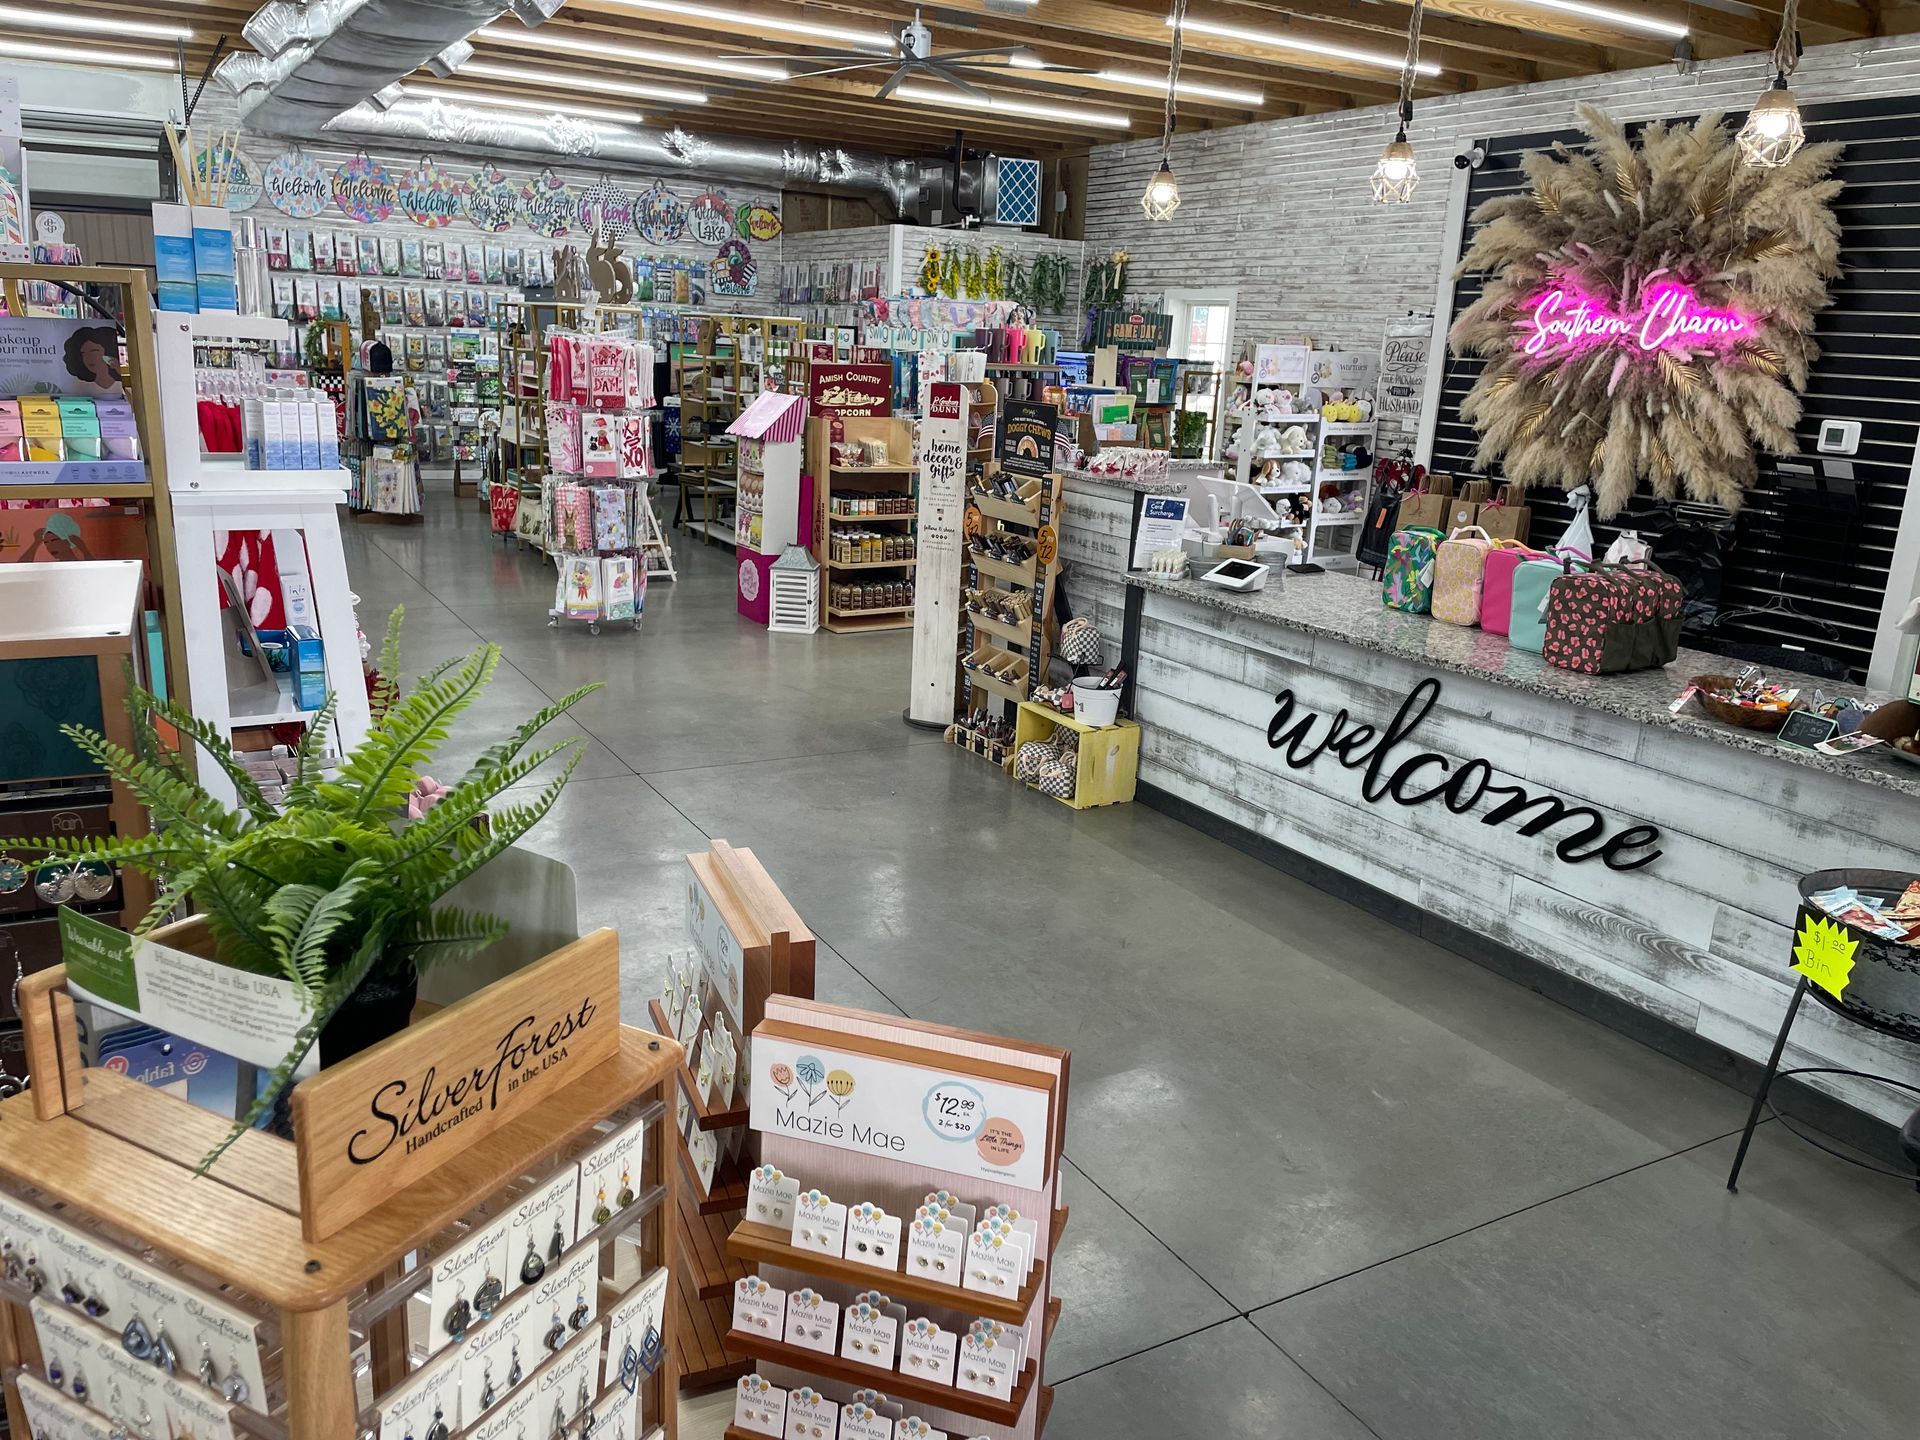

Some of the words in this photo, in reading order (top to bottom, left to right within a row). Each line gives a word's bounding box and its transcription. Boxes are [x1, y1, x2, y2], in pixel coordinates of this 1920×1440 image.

[270, 177, 327, 197] Welcome
[336, 179, 394, 201] Welcome
[404, 191, 458, 215] Welcome
[526, 198, 575, 217] Welcome
[1525, 291, 1633, 354] Southern
[1639, 290, 1744, 351] Charm
[829, 330, 850, 343] sig
[927, 328, 950, 347] swg
[22, 344, 57, 355] mind
[1385, 341, 1426, 363] Please
[834, 408, 871, 417] OPCORN
[932, 406, 958, 414] DUNN
[1379, 396, 1419, 413] HUSBAND
[1007, 423, 1027, 434] DOGGY
[1028, 425, 1052, 440] CHEWS
[931, 438, 962, 454] home
[954, 457, 963, 470] &
[930, 463, 956, 484] gifts
[492, 497, 515, 511] LOVE
[1149, 509, 1175, 518] Surcharge
[1038, 530, 1048, 545] 5
[1267, 678, 1664, 871] welcome
[66, 922, 106, 956] Wearable
[107, 949, 123, 962] art
[1803, 949, 1832, 978] Bin
[233, 975, 249, 991] the
[253, 981, 281, 999] USA
[406, 1098, 484, 1155] Handcrafted
[507, 1079, 519, 1092] in
[522, 1066, 539, 1084] the
[542, 1047, 568, 1070] USA
[775, 1107, 844, 1140] Mazie
[852, 1123, 906, 1153] Mae
[954, 1120, 971, 1132] $20
[1000, 1130, 1012, 1138] THE
[980, 1133, 1000, 1147] Little
[1000, 1135, 1022, 1150] Things
[998, 1146, 1010, 1155] LIFE
[752, 1184, 775, 1197] Mazie
[775, 1190, 793, 1200] Mae
[798, 1210, 821, 1223] Mazie
[822, 1216, 840, 1227] Mae
[851, 1224, 874, 1236] Mazie
[876, 1230, 894, 1240] Mae
[912, 1237, 935, 1250] Mazie
[937, 1243, 956, 1253] Mae
[970, 1250, 994, 1264] Mazie
[996, 1257, 1016, 1268] Mae
[738, 1296, 760, 1308] Mazie
[761, 1302, 779, 1311] Mae
[791, 1309, 813, 1321] Mazie
[815, 1315, 832, 1325] Mae
[849, 1323, 871, 1335] Mazie
[872, 1329, 891, 1339] Mae
[906, 1339, 929, 1351] Mazie
[931, 1344, 949, 1355] Mae
[963, 1352, 987, 1365] Mazie
[988, 1358, 1007, 1370] Mae
[740, 1393, 762, 1406] Mazie
[764, 1400, 781, 1410] Mae
[791, 1407, 813, 1420] Mazie
[814, 1414, 831, 1423] Mae
[844, 1421, 866, 1433] Mazie
[868, 1428, 885, 1438] Mae
